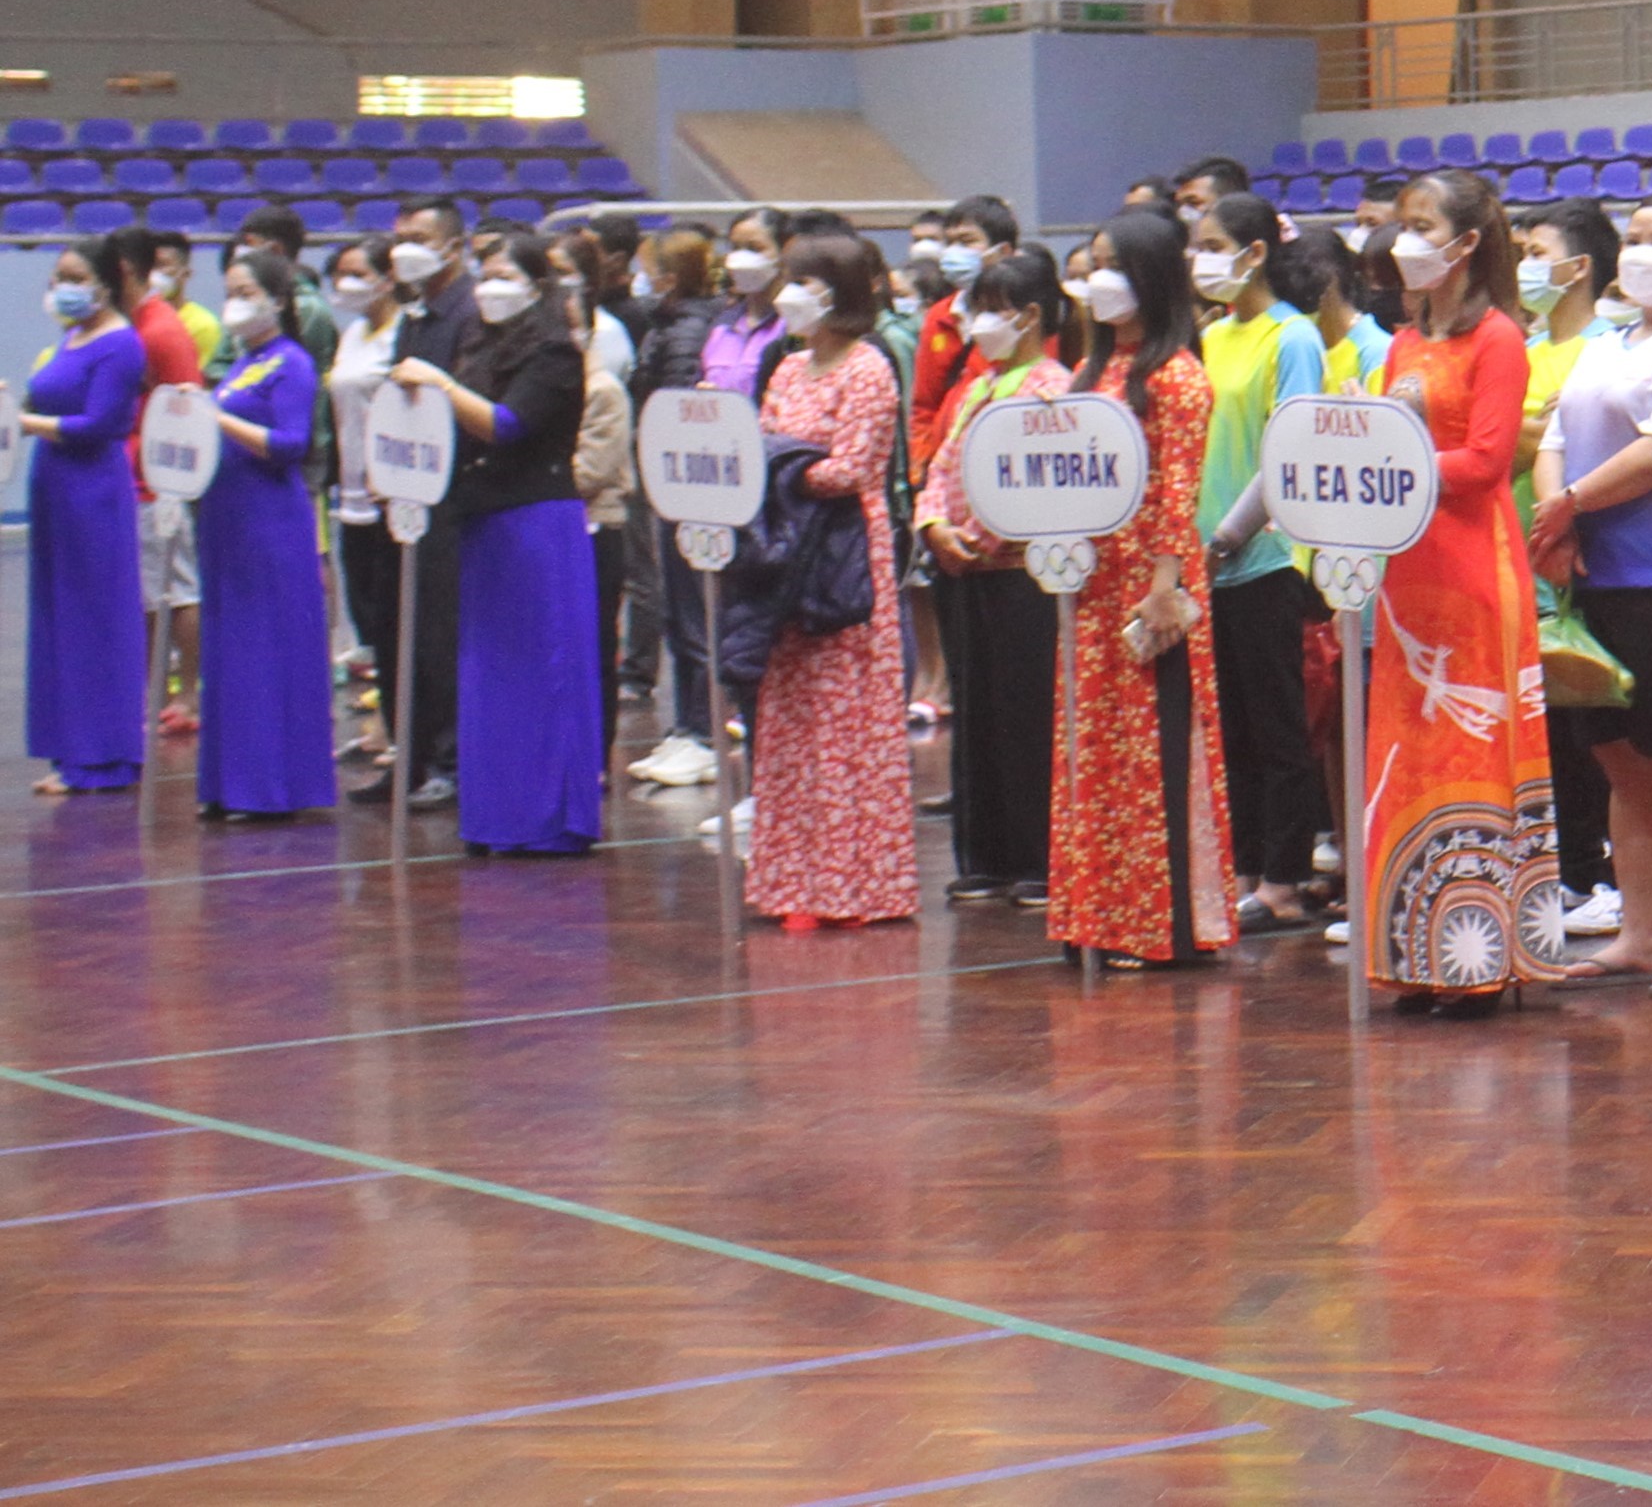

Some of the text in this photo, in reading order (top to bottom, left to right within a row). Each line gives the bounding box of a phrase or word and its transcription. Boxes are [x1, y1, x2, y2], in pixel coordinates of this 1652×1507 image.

[997, 454, 1020, 488] H.
[1282, 455, 1416, 507] H. EA SÚP
